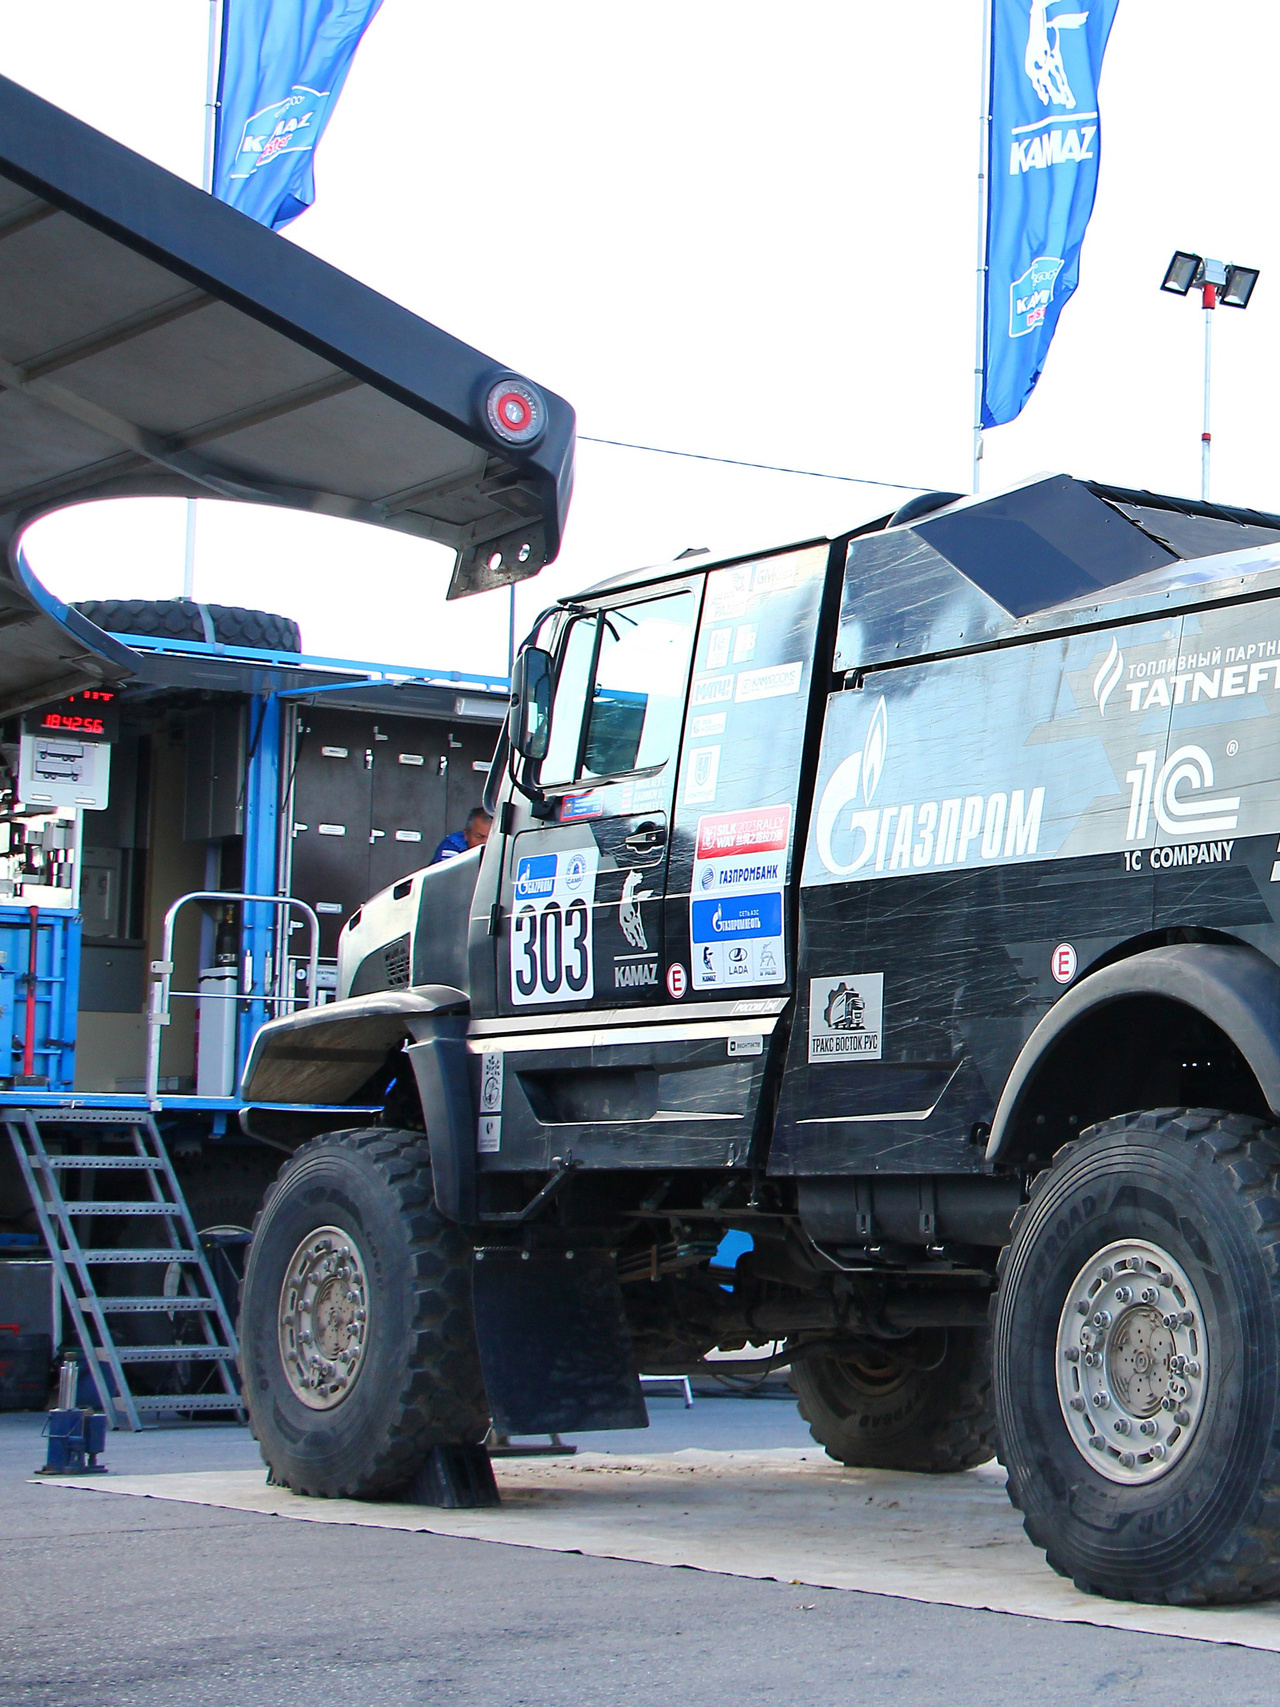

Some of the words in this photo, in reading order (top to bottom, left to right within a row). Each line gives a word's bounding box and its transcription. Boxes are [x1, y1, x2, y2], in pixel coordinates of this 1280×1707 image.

[1009, 126, 1097, 175] KAMAZ
[1016, 289, 1050, 314] KAM
[1128, 646, 1222, 680] ТОПЛИВНЫЙ
[717, 823, 738, 836] SILK
[757, 816, 785, 831] RALLY
[874, 786, 1047, 872] ГАЗПРОМ
[717, 834, 736, 848] WAY
[1150, 840, 1235, 870] COMPANY
[719, 864, 778, 885] ГАЗПРОМБАНК
[515, 898, 588, 996] 303
[614, 963, 659, 988] KAMAZ
[729, 965, 749, 975] LADA
[1058, 950, 1070, 976] E
[672, 970, 682, 991] E
[812, 1038, 835, 1053] ТРАКС
[835, 1036, 863, 1052] ВОСТОК
[864, 1034, 878, 1050] РУС
